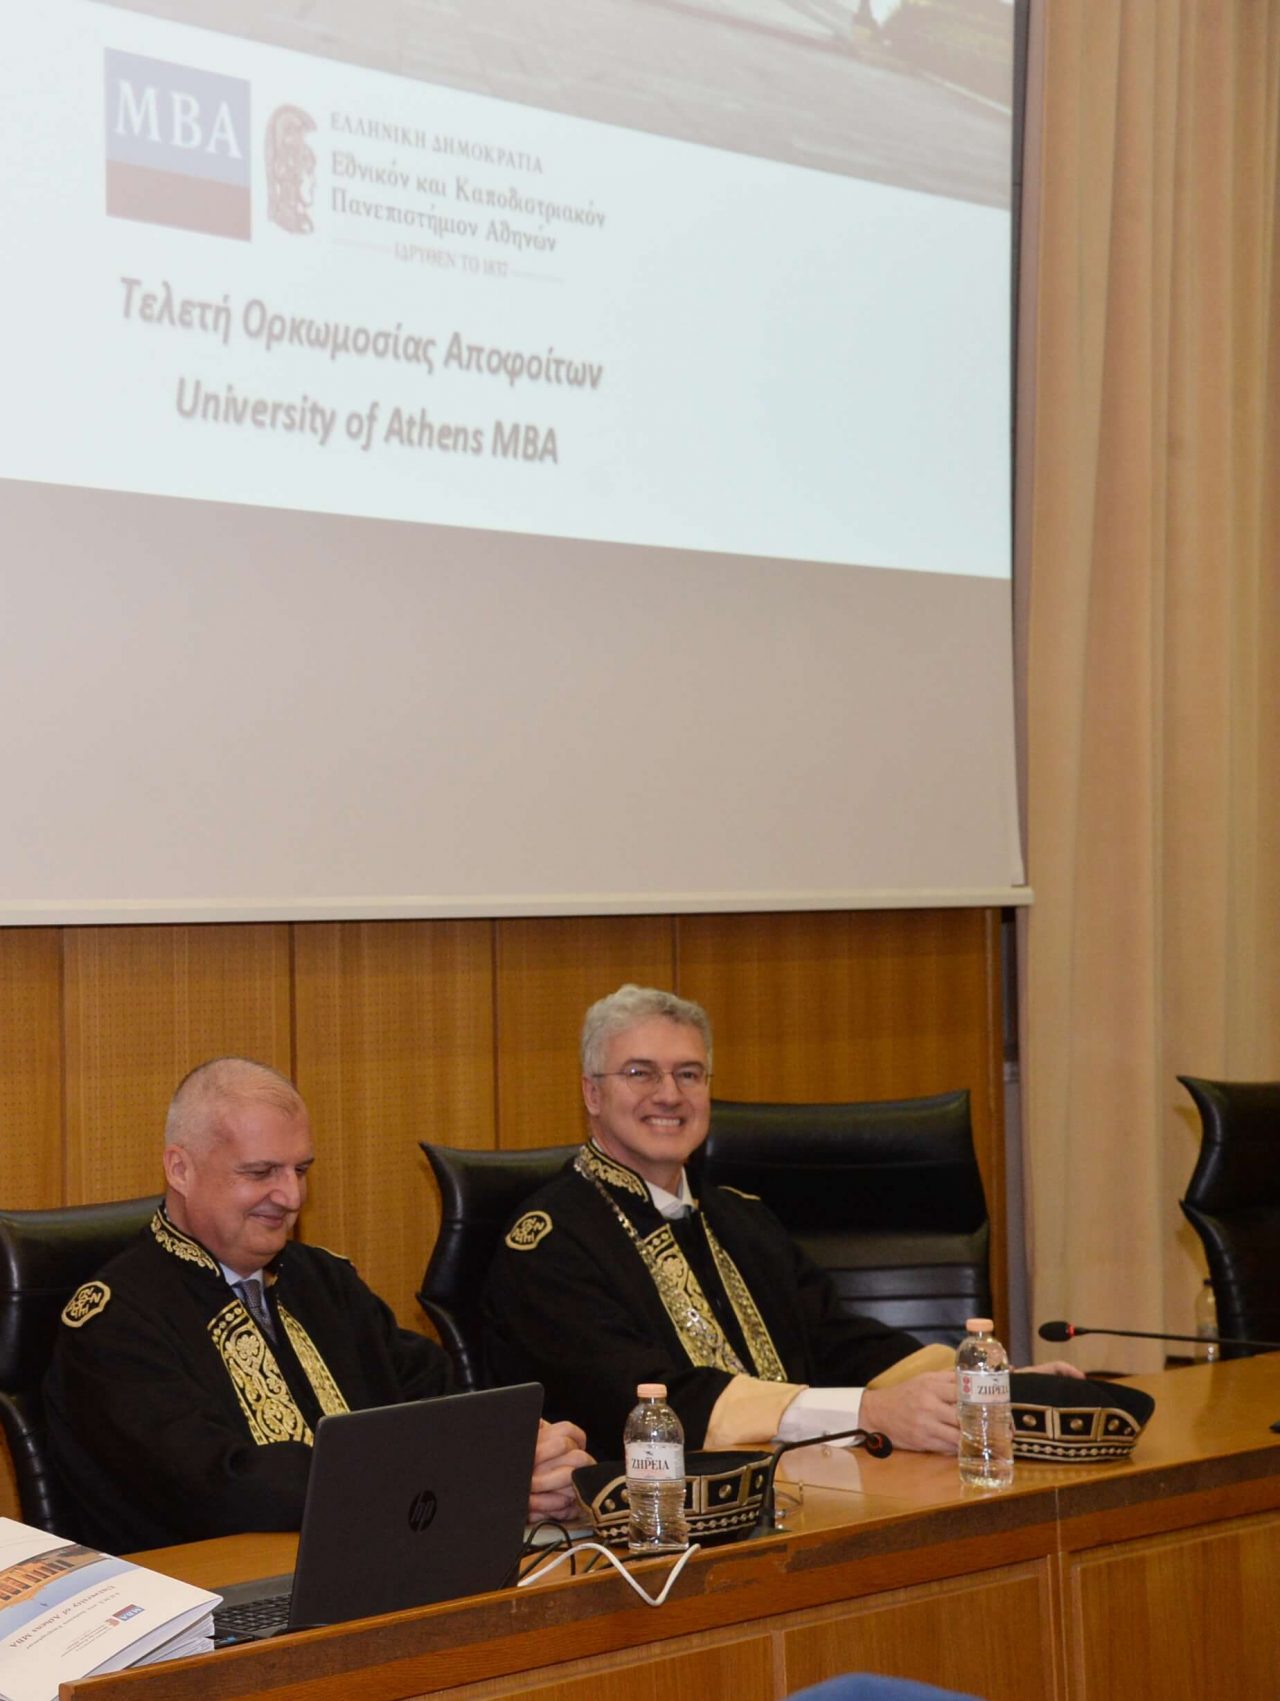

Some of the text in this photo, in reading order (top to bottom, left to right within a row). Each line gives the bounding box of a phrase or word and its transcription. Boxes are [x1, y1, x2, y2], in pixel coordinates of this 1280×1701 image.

[114, 77, 243, 161] MBA
[330, 111, 544, 175] ΕΛΛΗΝΙΚΗ ΔΗΜΟΚΡΑΤΙΑ
[331, 150, 607, 229] Εθνικόν και Καποδιστριακόν
[331, 187, 557, 252] Πανεπιστήμιον Αθηνών
[120, 276, 604, 390] Τελετή Ορκωμοσίας Αποφοίτων
[175, 377, 559, 464] University of Athens MBA
